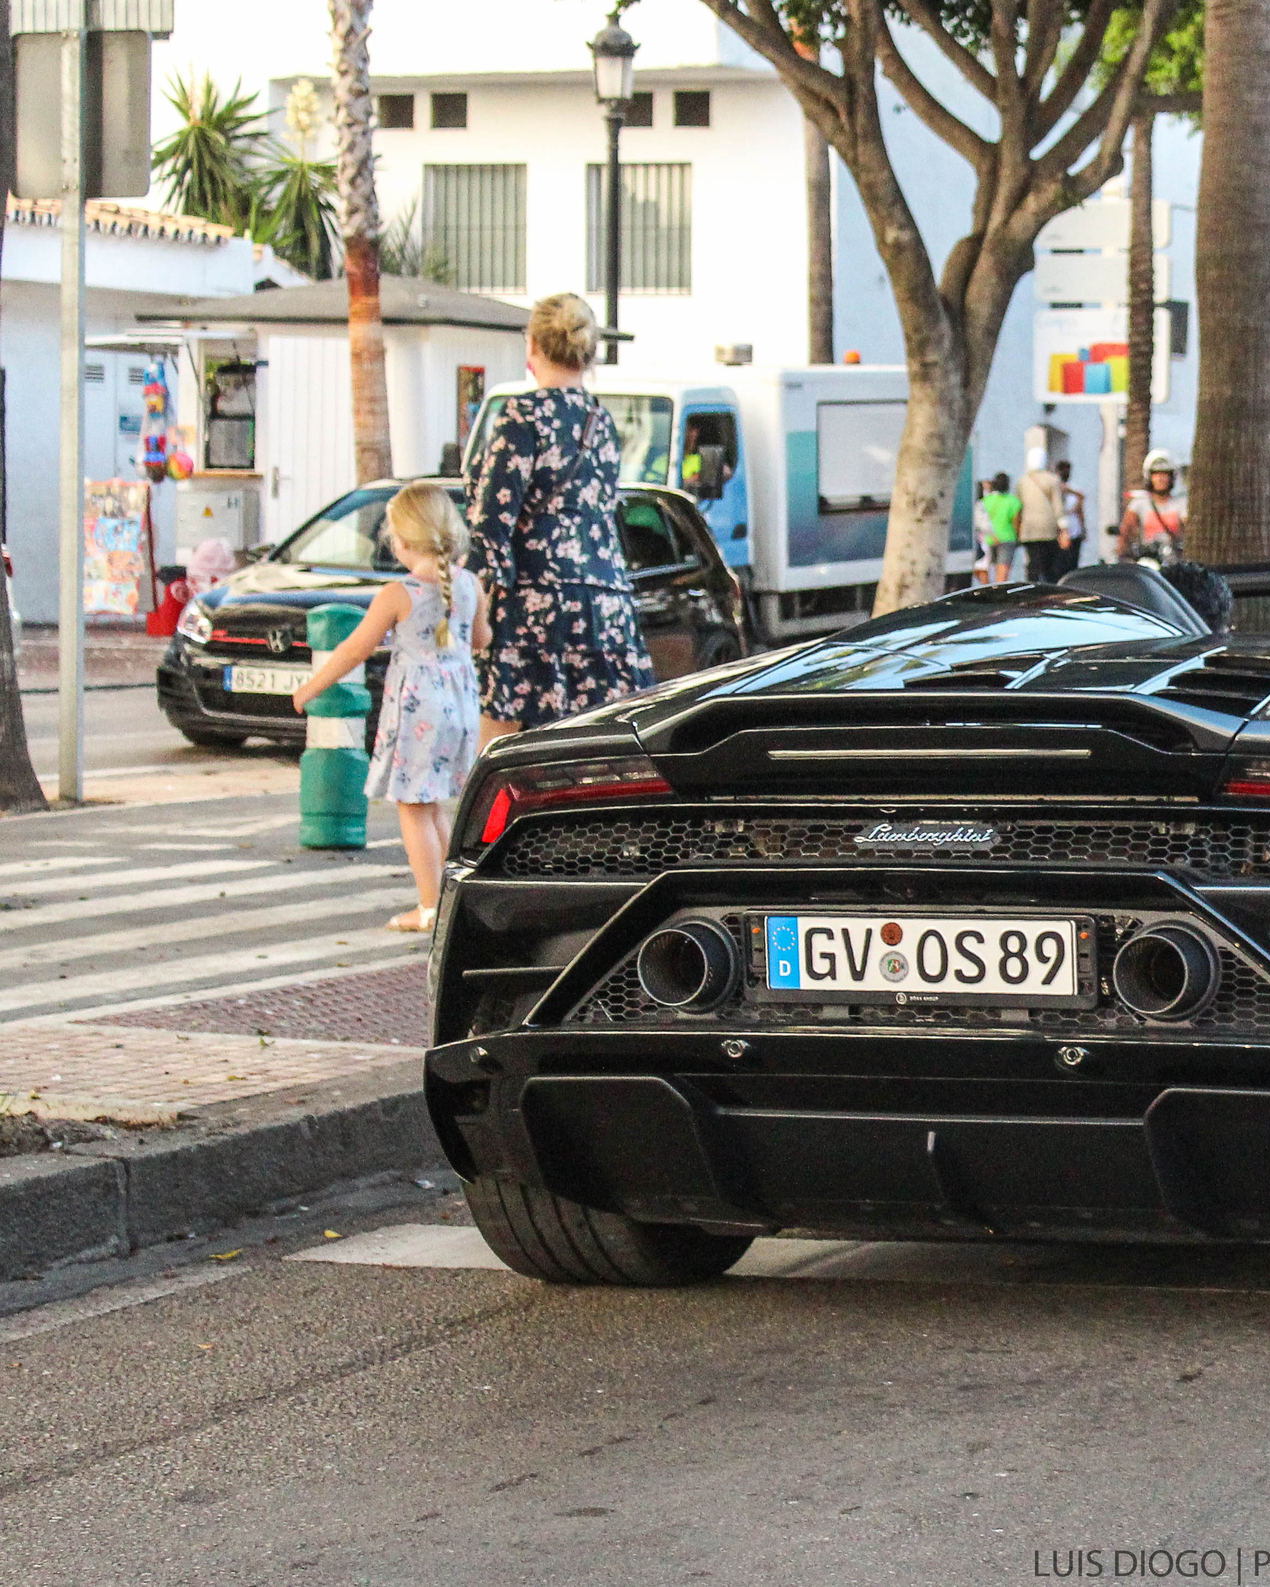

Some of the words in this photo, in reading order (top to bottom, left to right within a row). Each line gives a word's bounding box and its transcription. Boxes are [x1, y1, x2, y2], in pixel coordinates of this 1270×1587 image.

[854, 823, 994, 846] Lamborghini
[804, 927, 873, 981] GV
[779, 960, 791, 977] D
